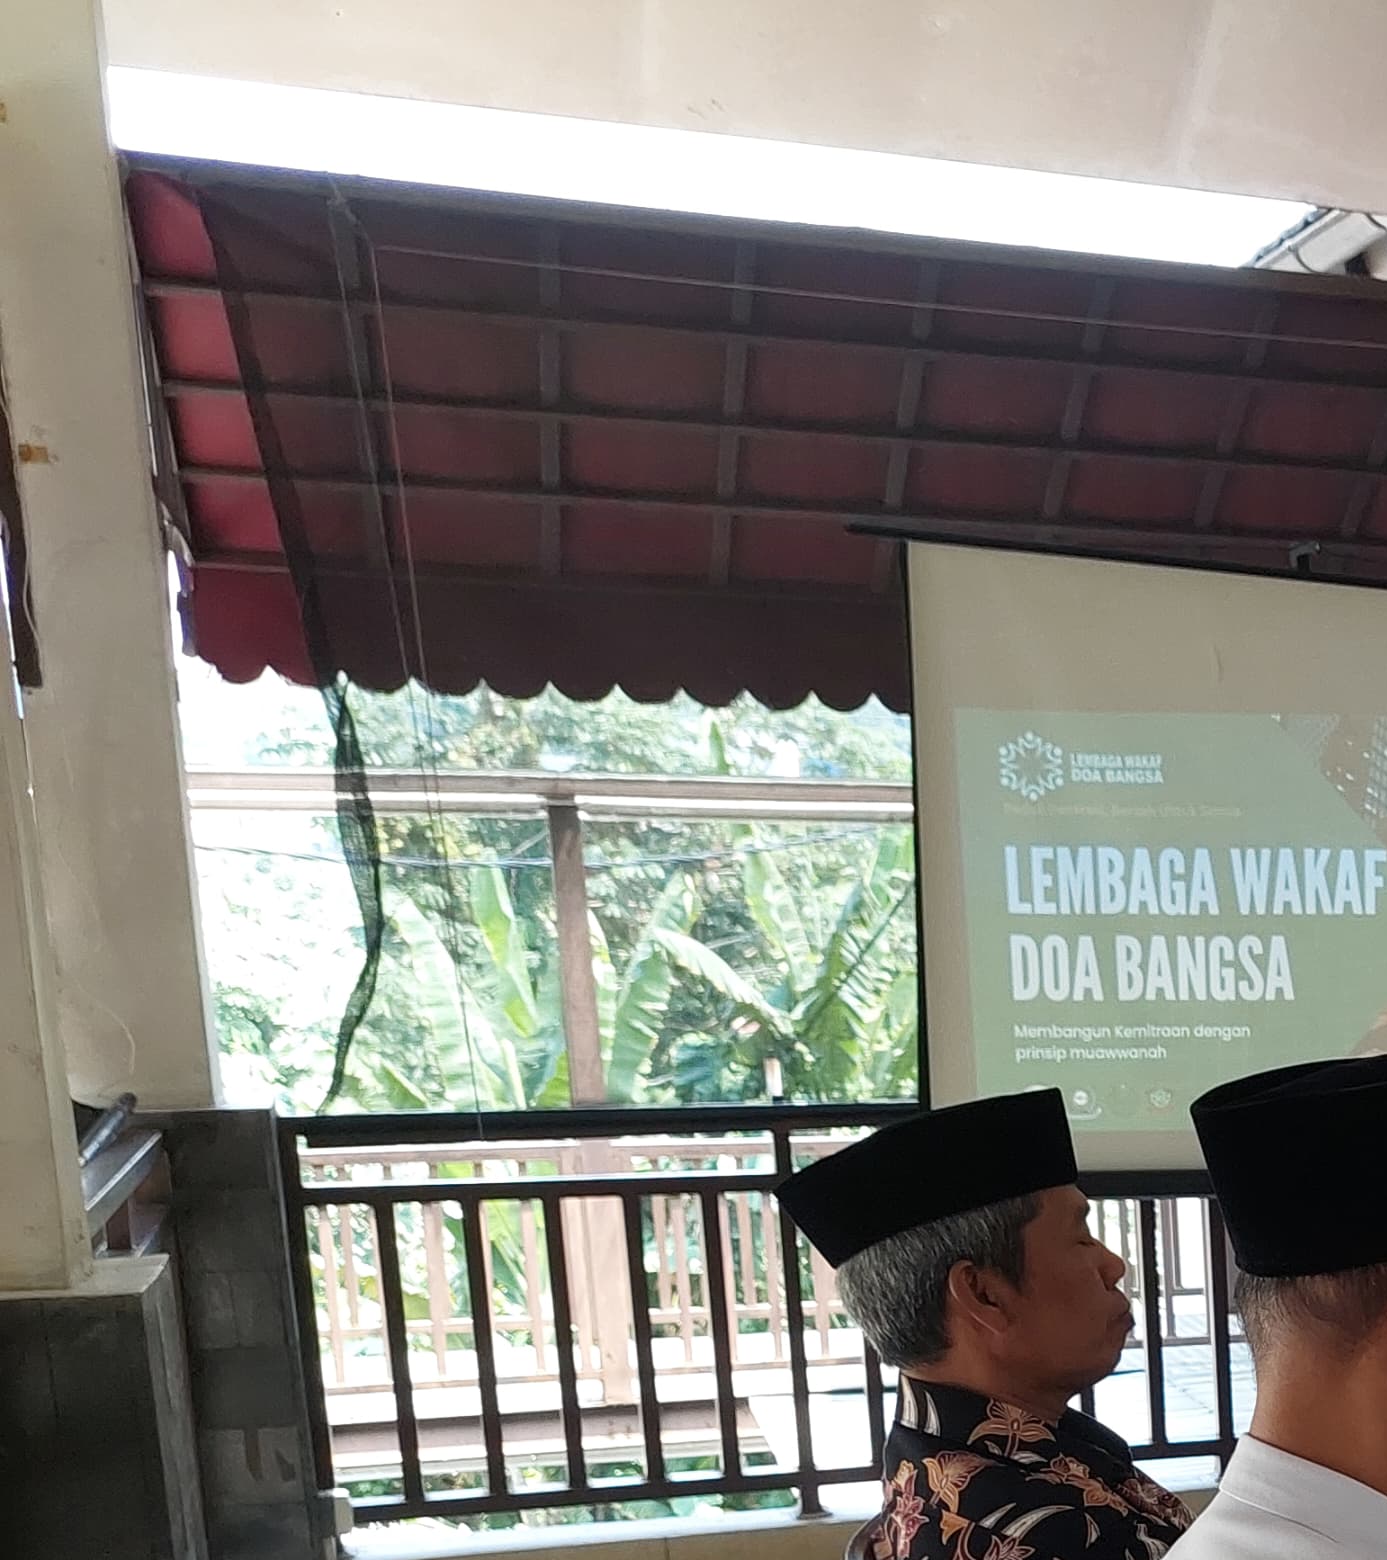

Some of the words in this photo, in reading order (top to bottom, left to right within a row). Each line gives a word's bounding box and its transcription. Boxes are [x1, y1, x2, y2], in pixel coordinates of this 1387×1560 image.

[1070, 752, 1124, 769] LEMBAGA
[1125, 753, 1163, 769] WAKAF
[1070, 768, 1102, 783] DOA
[1106, 768, 1164, 784] BANGSA
[1004, 845, 1219, 916] LEMBAGA
[1230, 847, 1387, 916] WAKAF
[1008, 933, 1105, 1001] DOA
[1114, 934, 1296, 1001] BANGSA
[1014, 1024, 1111, 1042] Membangun
[1114, 1024, 1190, 1039] Kemitraan
[1193, 1024, 1251, 1041] dengan
[1015, 1046, 1067, 1063] prinsip
[1070, 1046, 1167, 1061] muawwanah
